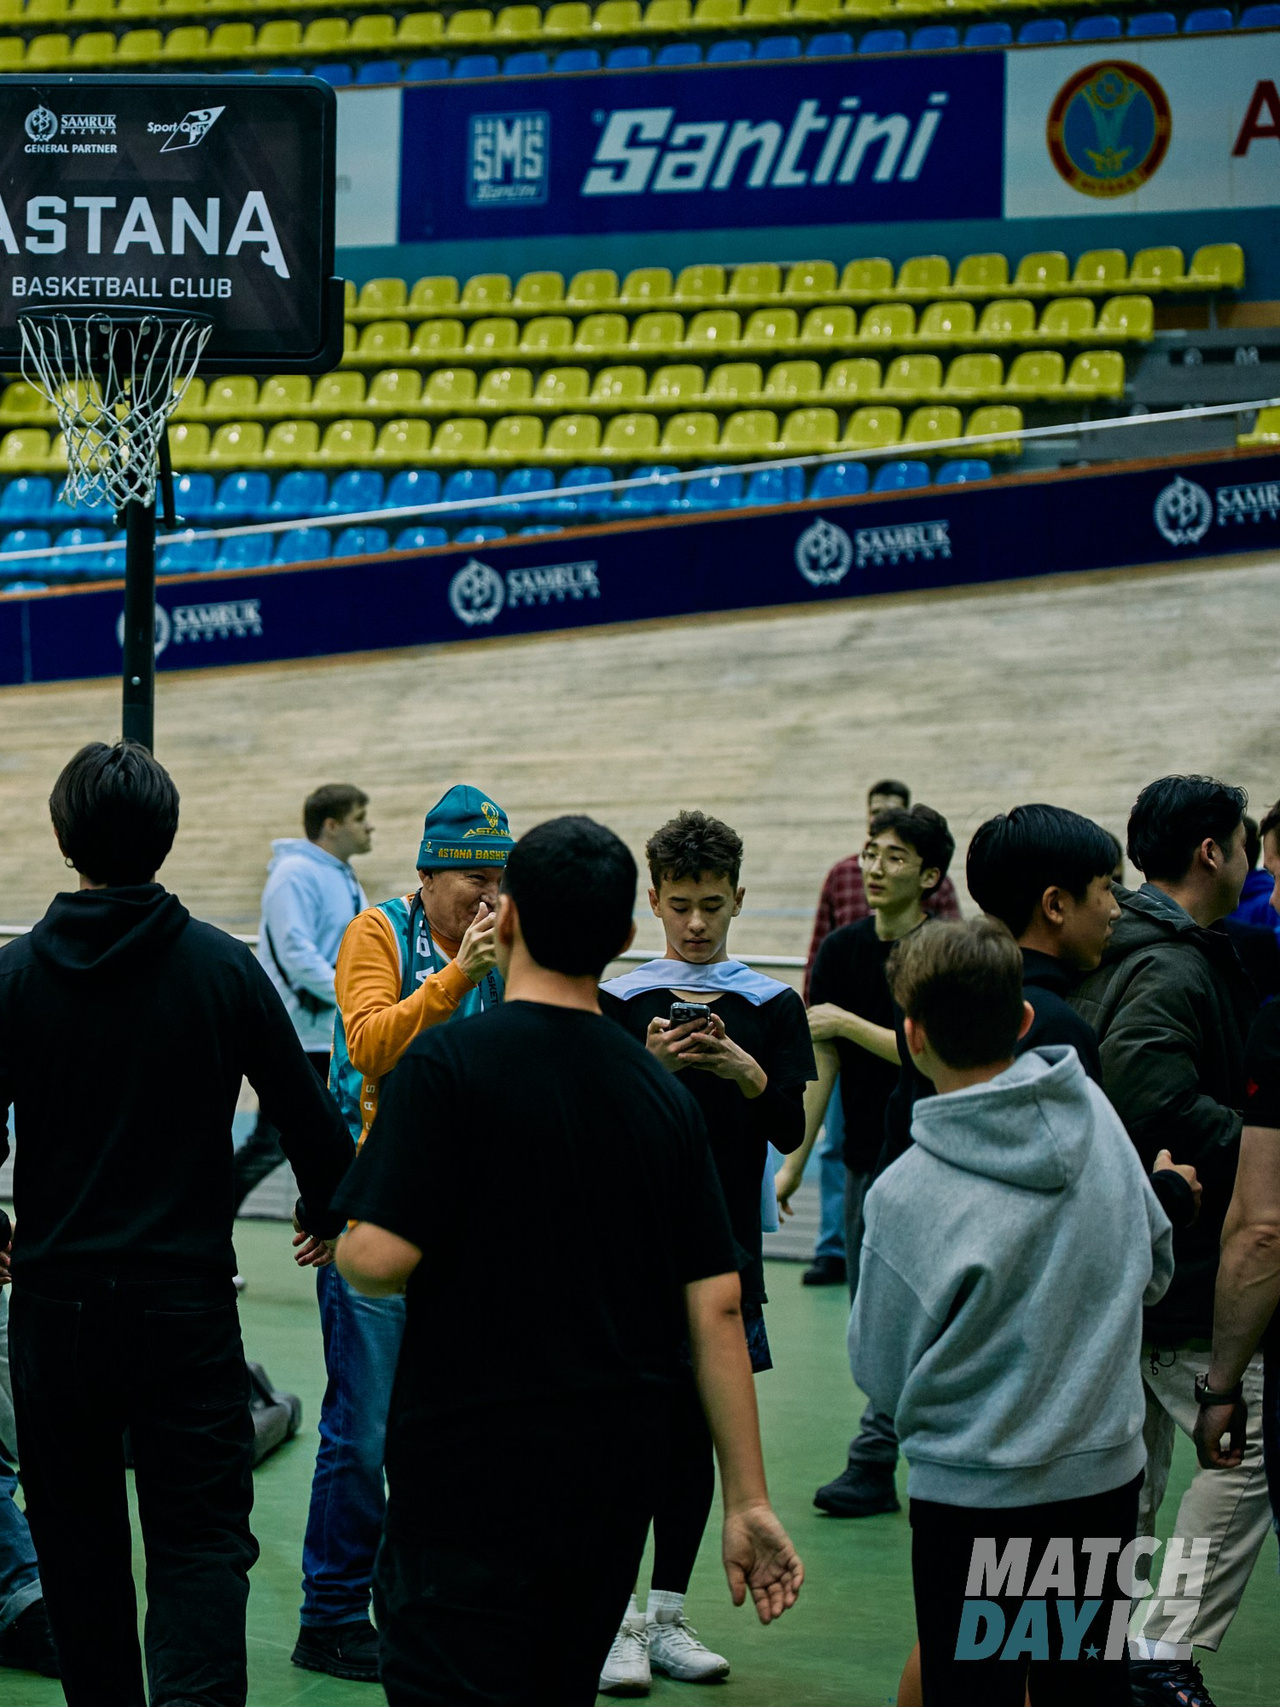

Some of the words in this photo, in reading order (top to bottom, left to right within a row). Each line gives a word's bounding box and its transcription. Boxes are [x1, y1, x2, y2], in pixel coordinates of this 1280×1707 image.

[61, 115, 117, 128] SAMRUK
[147, 122, 177, 133] Sport
[24, 144, 69, 153] GENERAL
[72, 144, 118, 153] PARTNER
[581, 92, 948, 197] Santini
[12, 276, 162, 297] BASKETBALL
[170, 277, 232, 298] CLUB
[462, 827, 510, 839] ASTAN
[438, 848, 472, 859] ASTANA
